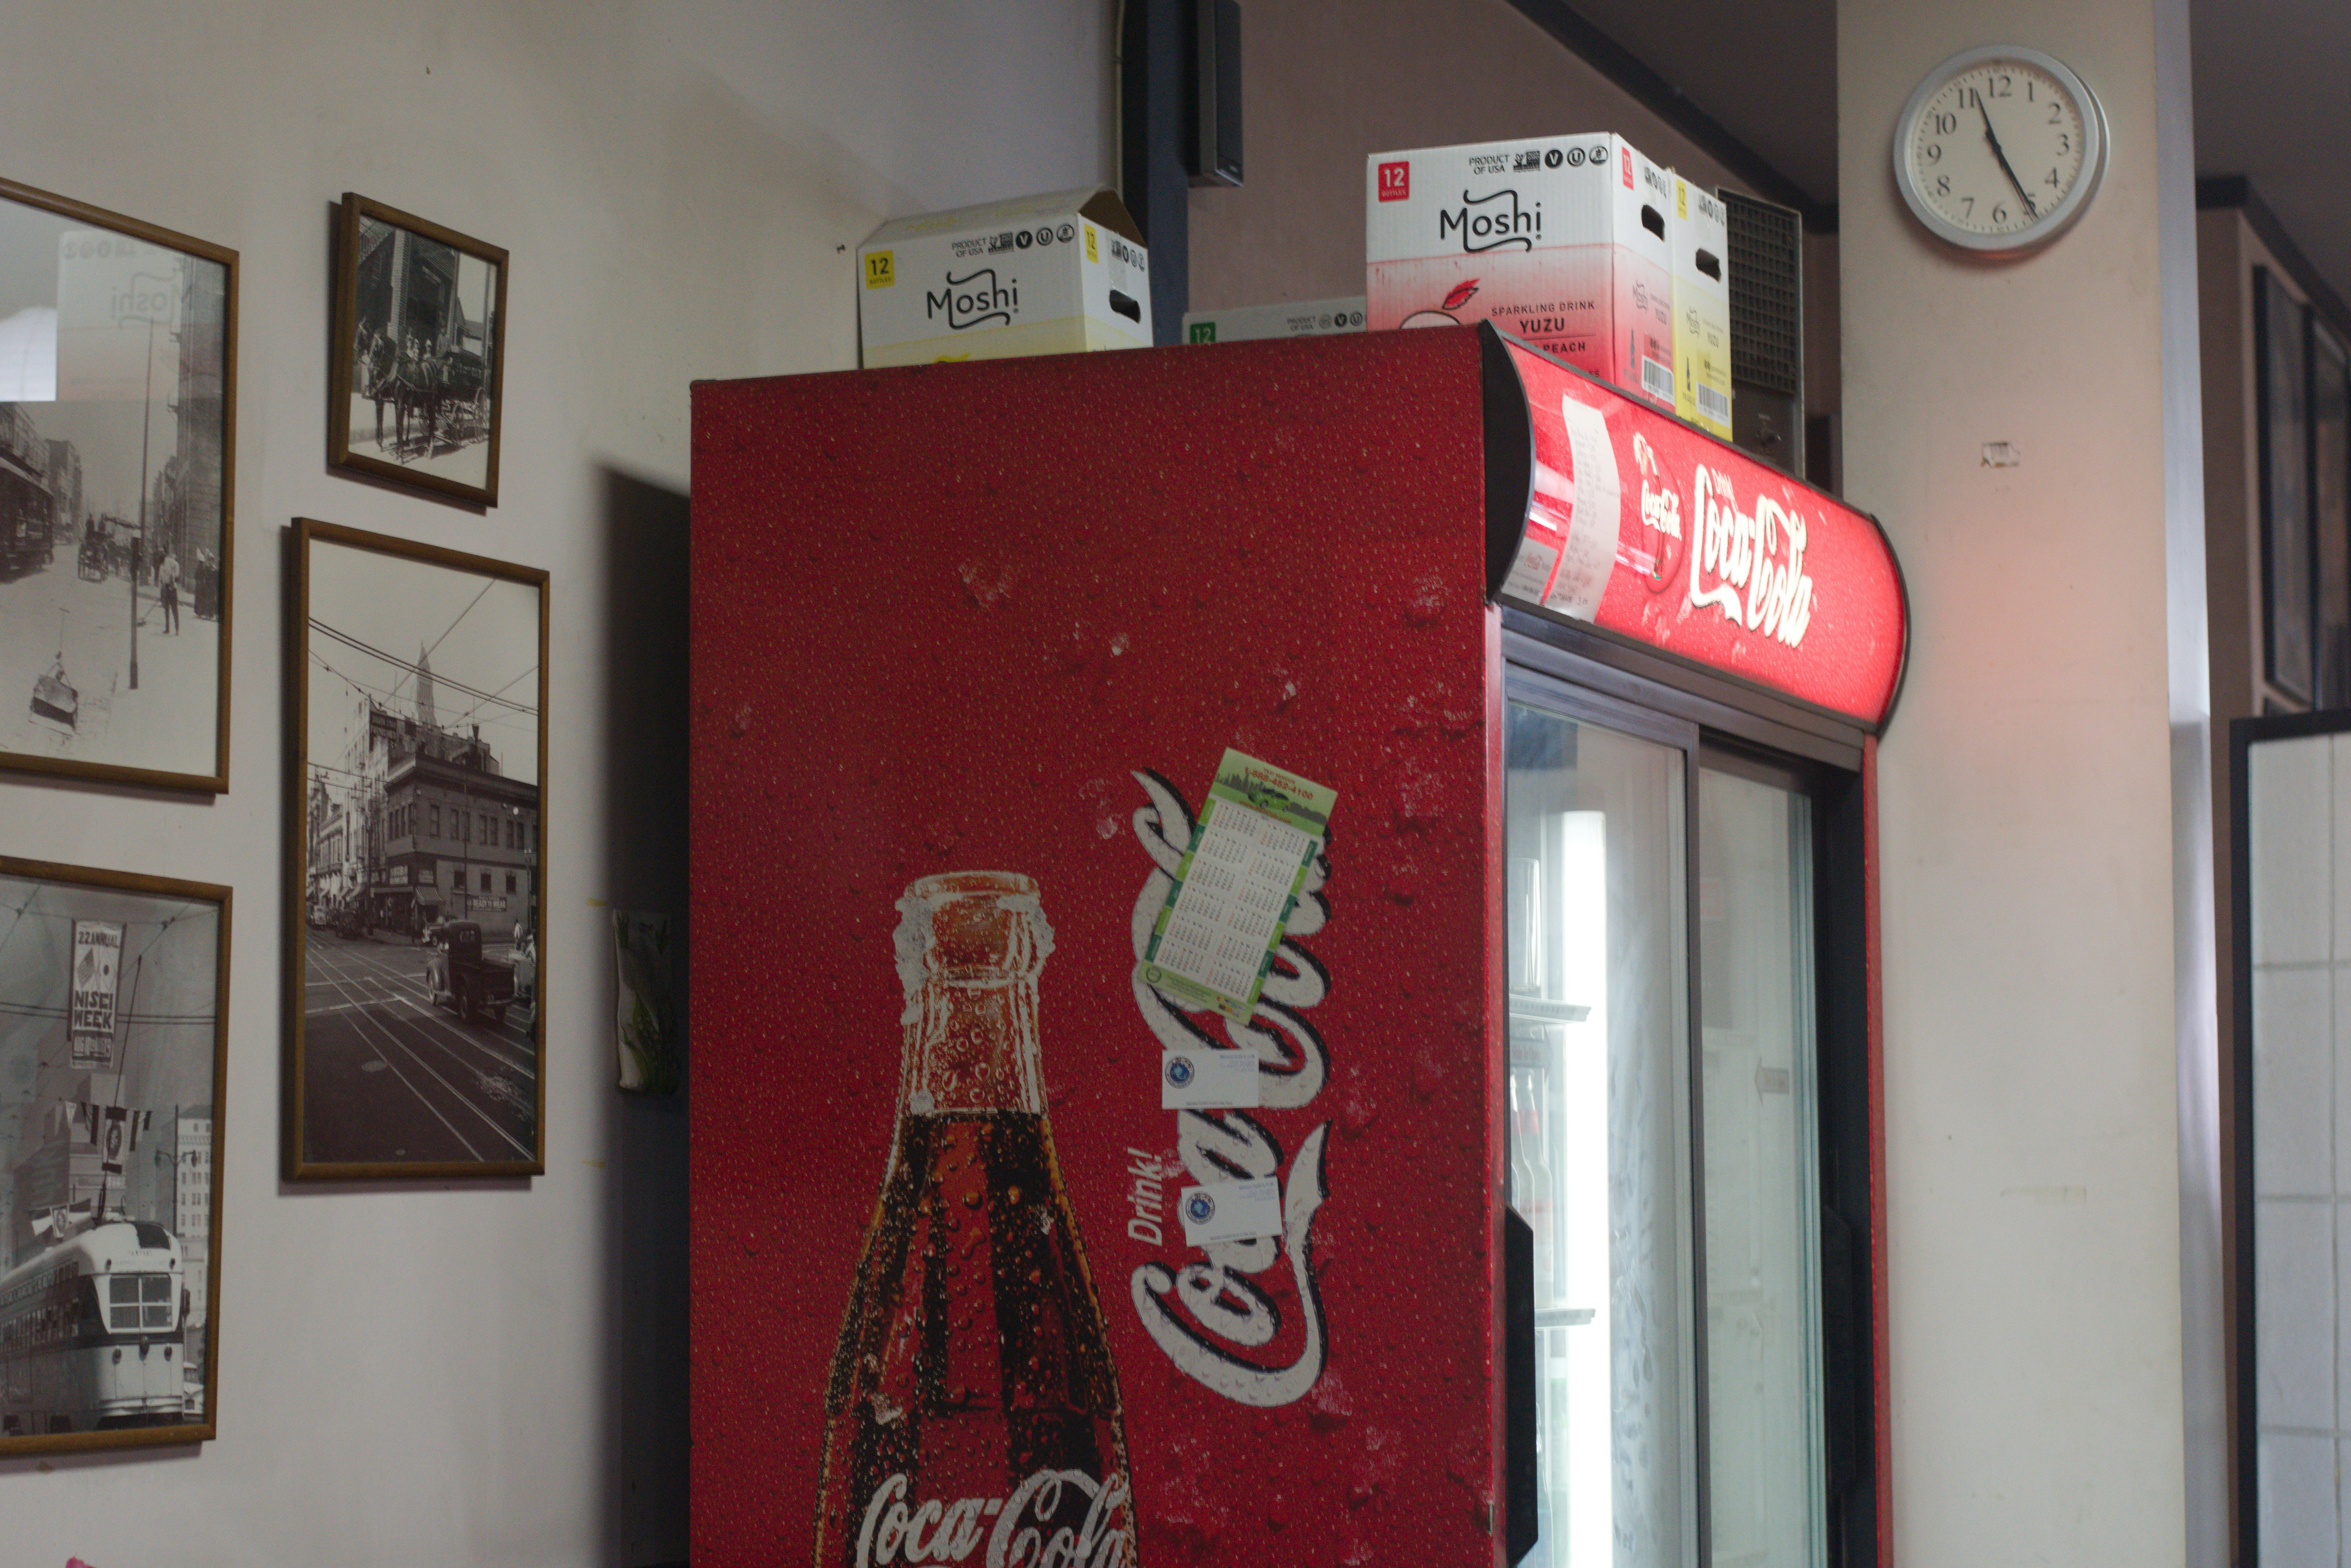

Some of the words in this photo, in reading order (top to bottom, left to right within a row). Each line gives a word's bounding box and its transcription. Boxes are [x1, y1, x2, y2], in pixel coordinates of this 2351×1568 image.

[1989, 76, 2011, 98] 12
[2028, 81, 2034, 102] 1
[1959, 87, 1975, 109] 11
[2048, 102, 2061, 124] 2
[1935, 113, 1957, 135] 10
[1927, 144, 1942, 166] 9
[2056, 133, 2070, 156] 3
[1469, 155, 1510, 166] PRODUCT
[1474, 166, 1486, 175] OF
[1488, 165, 1506, 174] USA
[1384, 167, 1405, 187] 12
[1937, 174, 1951, 197] 8
[2045, 167, 2060, 188] 4
[1961, 197, 1975, 219] 7
[1993, 202, 2007, 224] 6
[1440, 189, 1542, 254] Moshi
[951, 237, 987, 250] PRODUCT
[968, 247, 983, 256] USA
[870, 257, 889, 275] 12
[926, 268, 1018, 330] Moshi
[1491, 303, 1555, 316] SPARKLING
[1559, 300, 1595, 312] DRINK
[1195, 326, 1212, 343] 12
[1519, 317, 1565, 333] YUZU
[1543, 342, 1586, 353] PEACH
[1690, 463, 1813, 648] Coca-Cola
[74, 990, 114, 1011] NISEI
[74, 1009, 112, 1029] WEEK
[1127, 1147, 1162, 1246] Drink!
